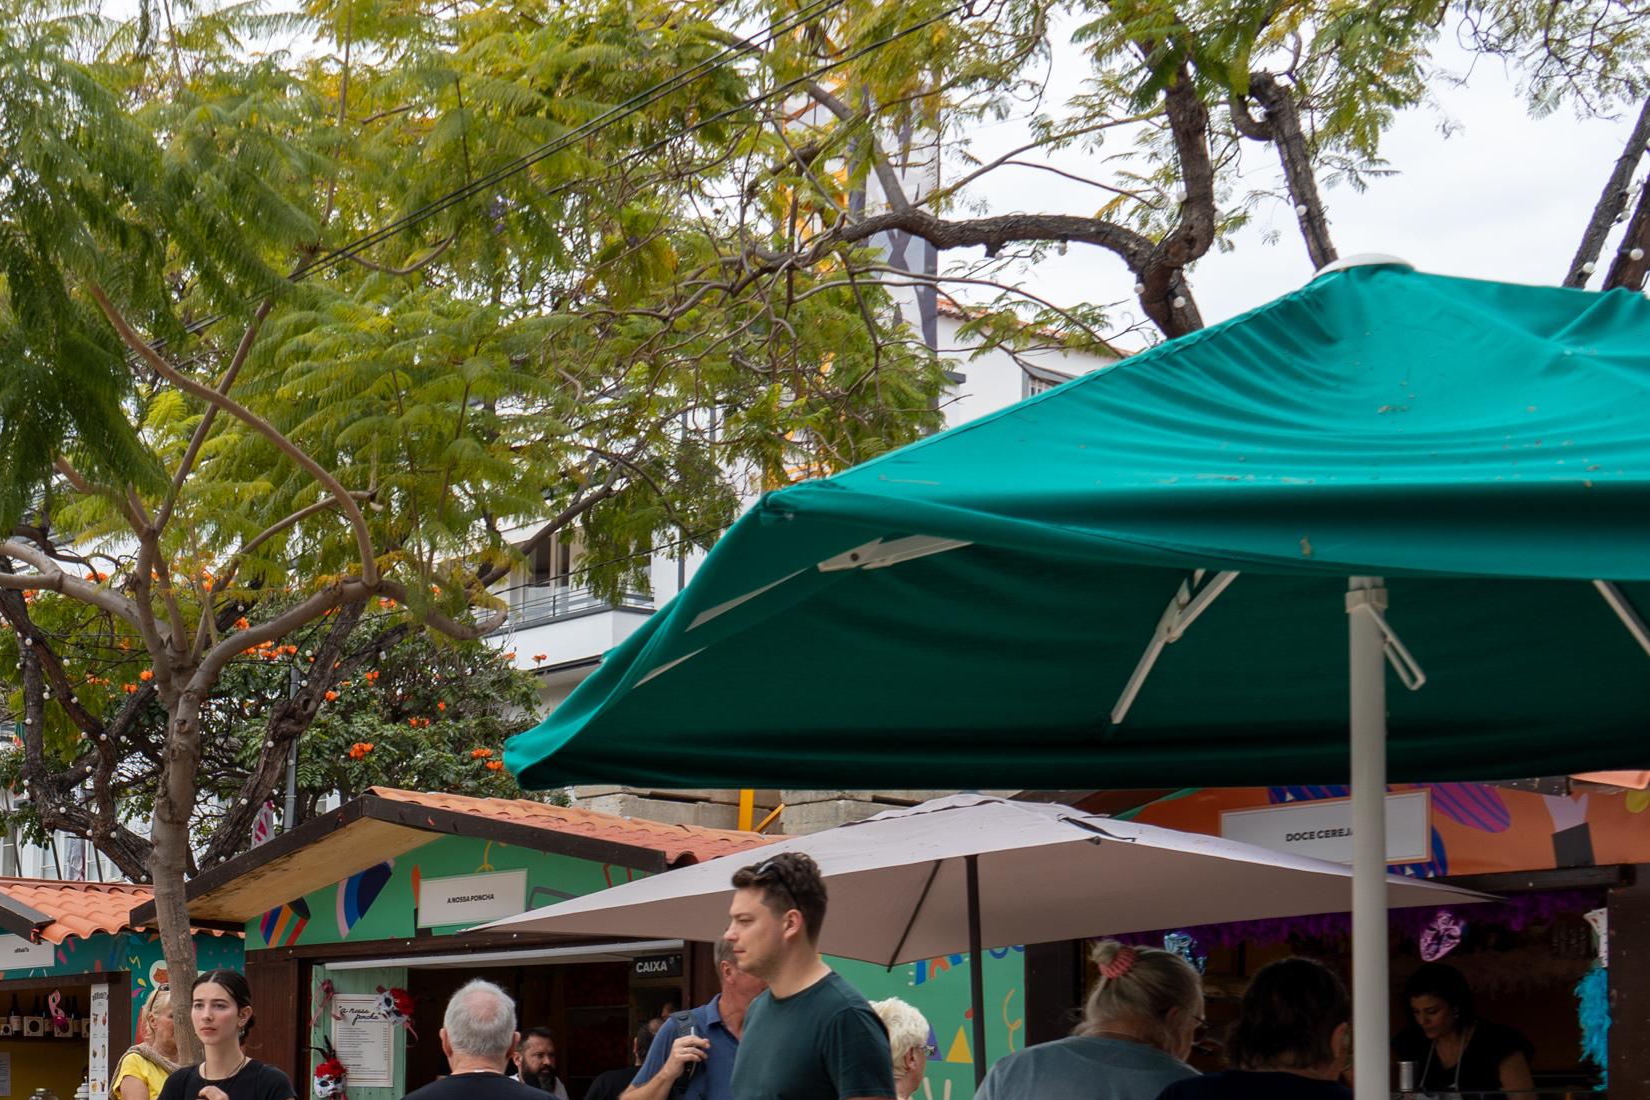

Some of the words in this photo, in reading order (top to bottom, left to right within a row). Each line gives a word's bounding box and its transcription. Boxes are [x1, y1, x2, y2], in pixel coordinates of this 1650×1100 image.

[1285, 831, 1316, 842] DOCE
[1316, 827, 1353, 839] CEREJ
[452, 895, 470, 904] NOSSA
[470, 893, 495, 902] PONCHA
[636, 960, 668, 973] CAIXA
